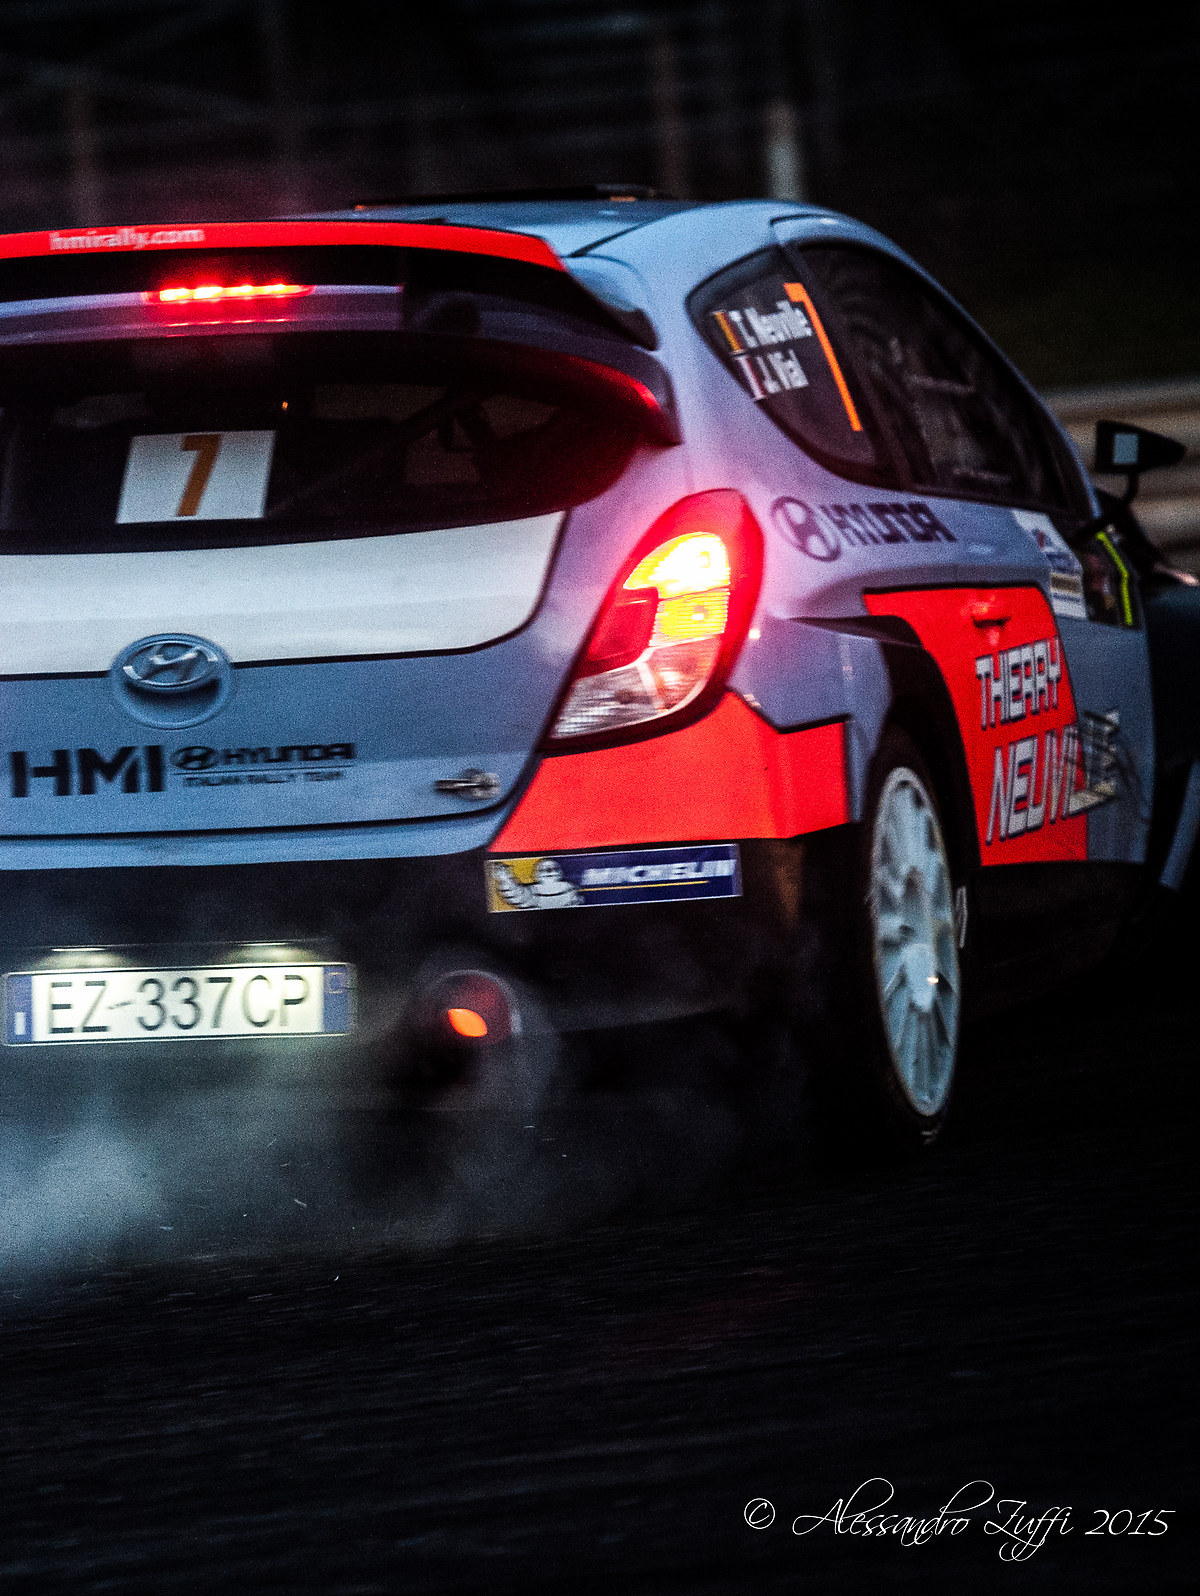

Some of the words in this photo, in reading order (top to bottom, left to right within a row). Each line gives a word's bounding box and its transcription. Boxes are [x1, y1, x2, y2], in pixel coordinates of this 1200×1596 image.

[728, 309, 759, 349] T.
[174, 433, 222, 517] 7
[975, 635, 1062, 732] THIERRY
[9, 745, 166, 798] HMI
[580, 859, 738, 887] MICHELIN
